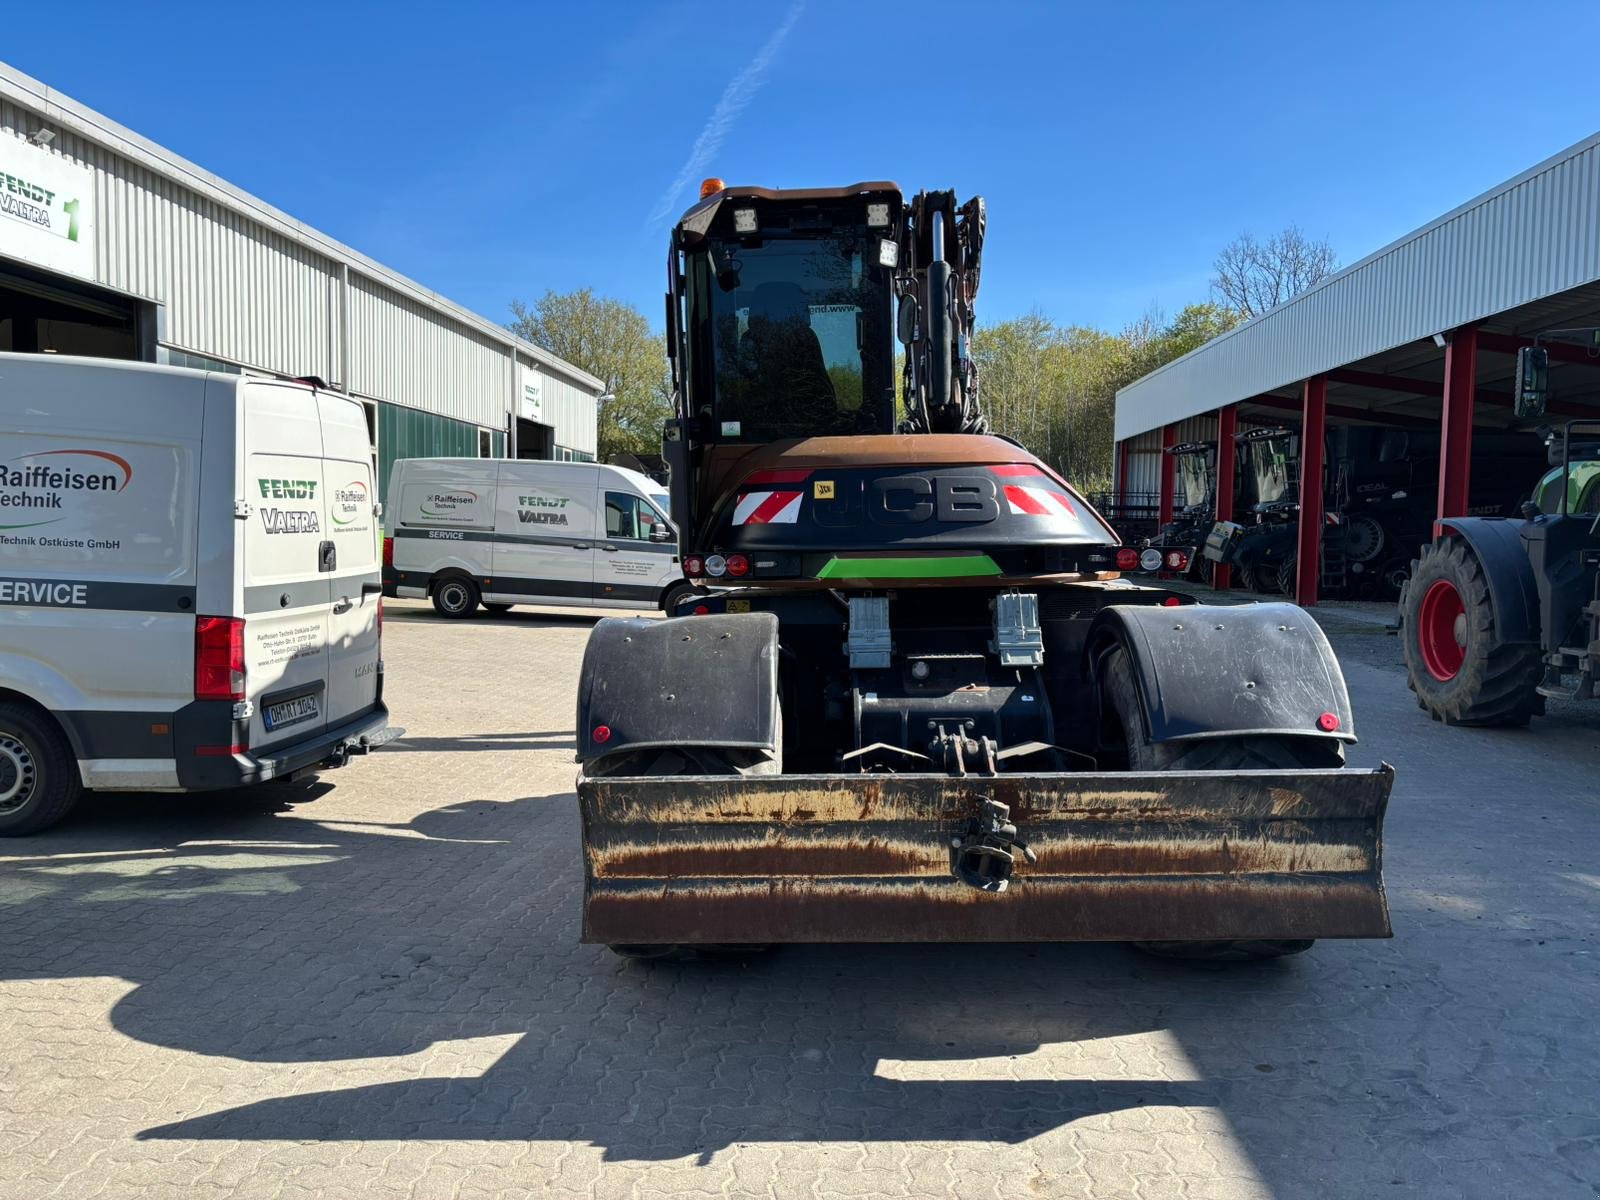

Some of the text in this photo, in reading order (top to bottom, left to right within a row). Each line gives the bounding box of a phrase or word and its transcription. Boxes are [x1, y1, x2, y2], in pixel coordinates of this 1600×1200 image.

[0, 191, 51, 228] VALTRA
[63, 198, 80, 242] 1
[0, 465, 117, 491] Raiffeisen
[0, 491, 62, 509] echnik
[258, 479, 317, 500] FENDT
[434, 495, 473, 504] Raiffeisen
[518, 495, 570, 508] FENDT
[812, 475, 1000, 528] JCB
[260, 508, 320, 534] VALTRA
[517, 509, 568, 526] VALTRA
[0, 535, 120, 550] Technik Ostküste GmbH
[428, 530, 464, 540] SERVICE
[270, 704, 283, 723] OH
[286, 701, 297, 719] RT
